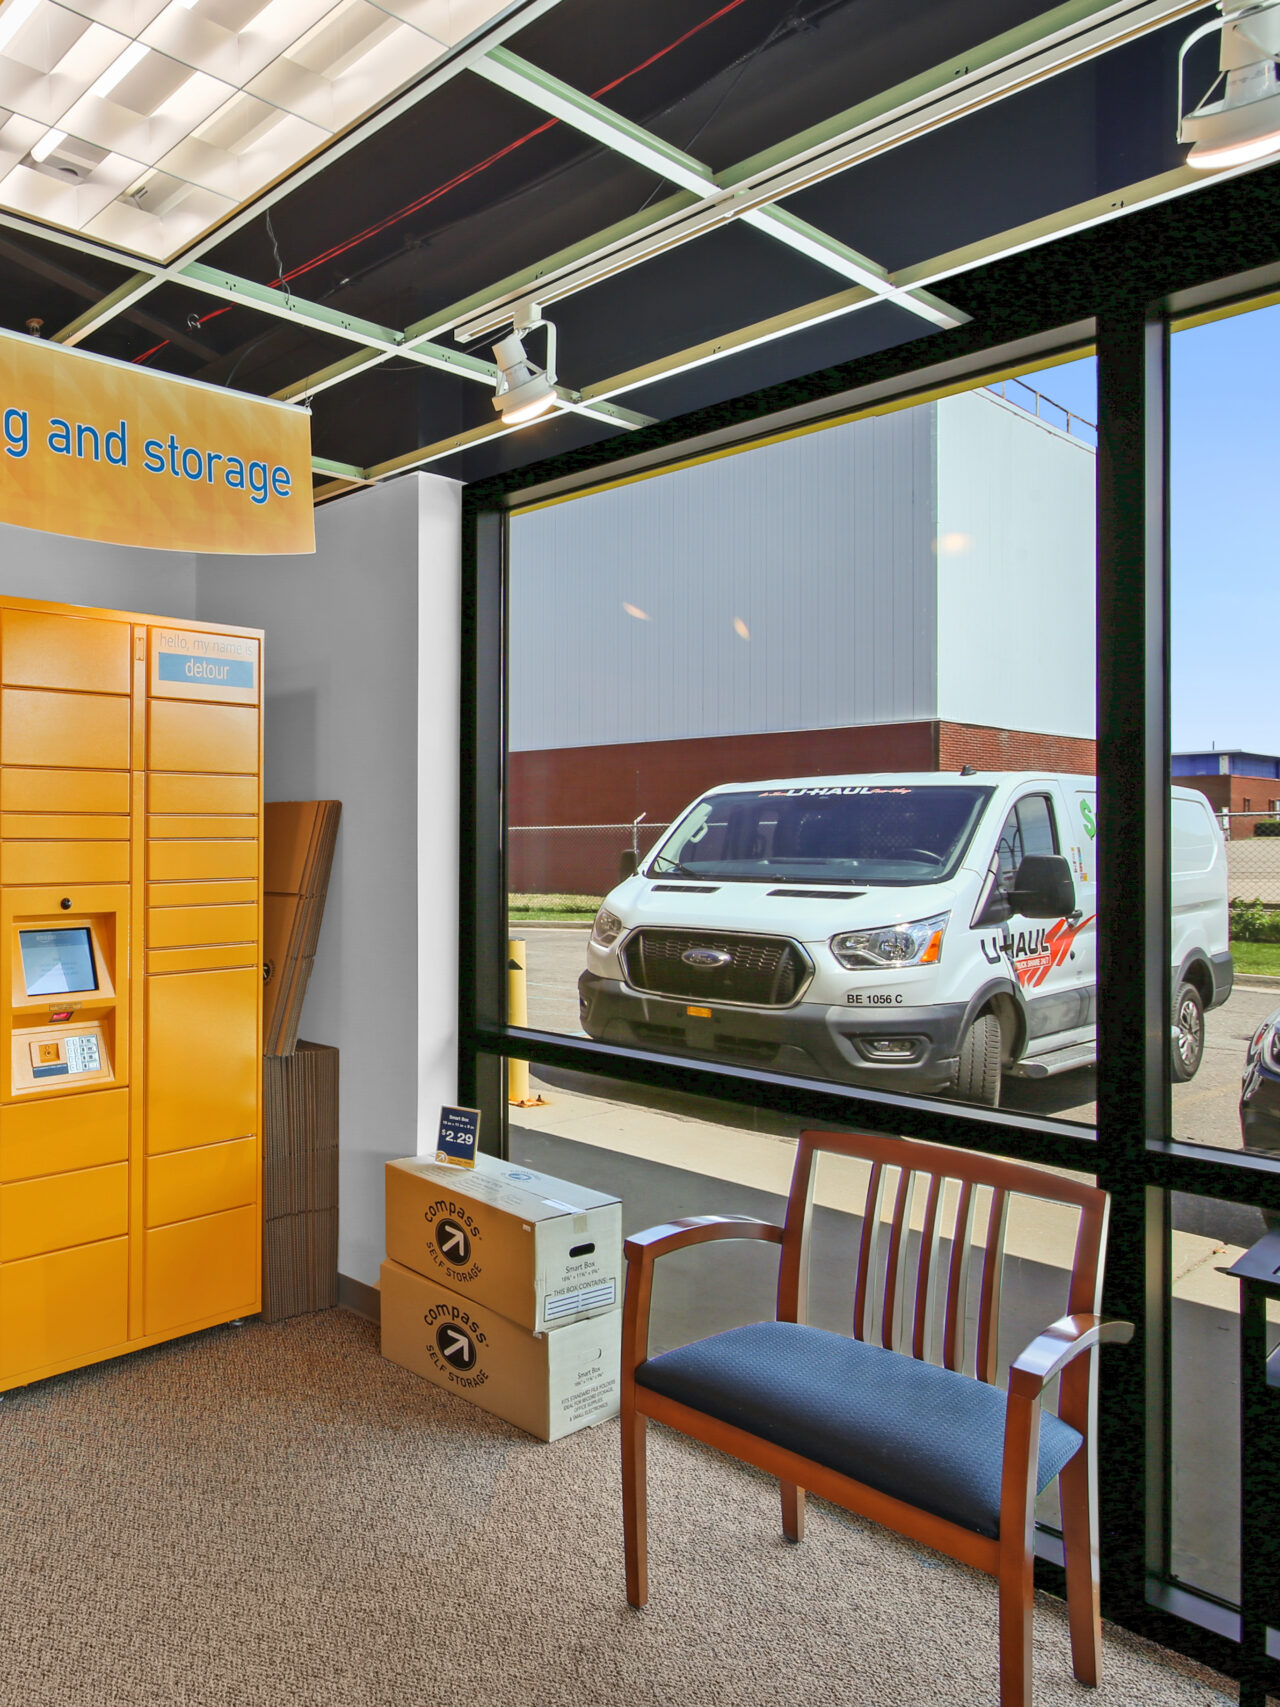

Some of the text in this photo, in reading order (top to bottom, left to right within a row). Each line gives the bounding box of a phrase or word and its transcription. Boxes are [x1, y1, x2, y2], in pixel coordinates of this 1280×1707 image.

[48, 418, 129, 468] and
[143, 434, 292, 505] storage
[160, 632, 254, 656] hello, my name is
[185, 658, 230, 680] detour
[786, 787, 871, 796] U-HAUL
[981, 928, 1049, 965] U-HAUL
[847, 994, 903, 1004] BE 1056 C
[441, 1129, 474, 1145] $2.29
[424, 1200, 480, 1238] compass
[426, 1241, 482, 1282] SELF STORAGE
[565, 1261, 595, 1274] Smart Box
[553, 1288, 566, 1296] THIS
[566, 1285, 578, 1293] BOX
[424, 1303, 486, 1344] compass
[426, 1344, 489, 1388] SELF STORAGE
[577, 1370, 591, 1380] Smart
